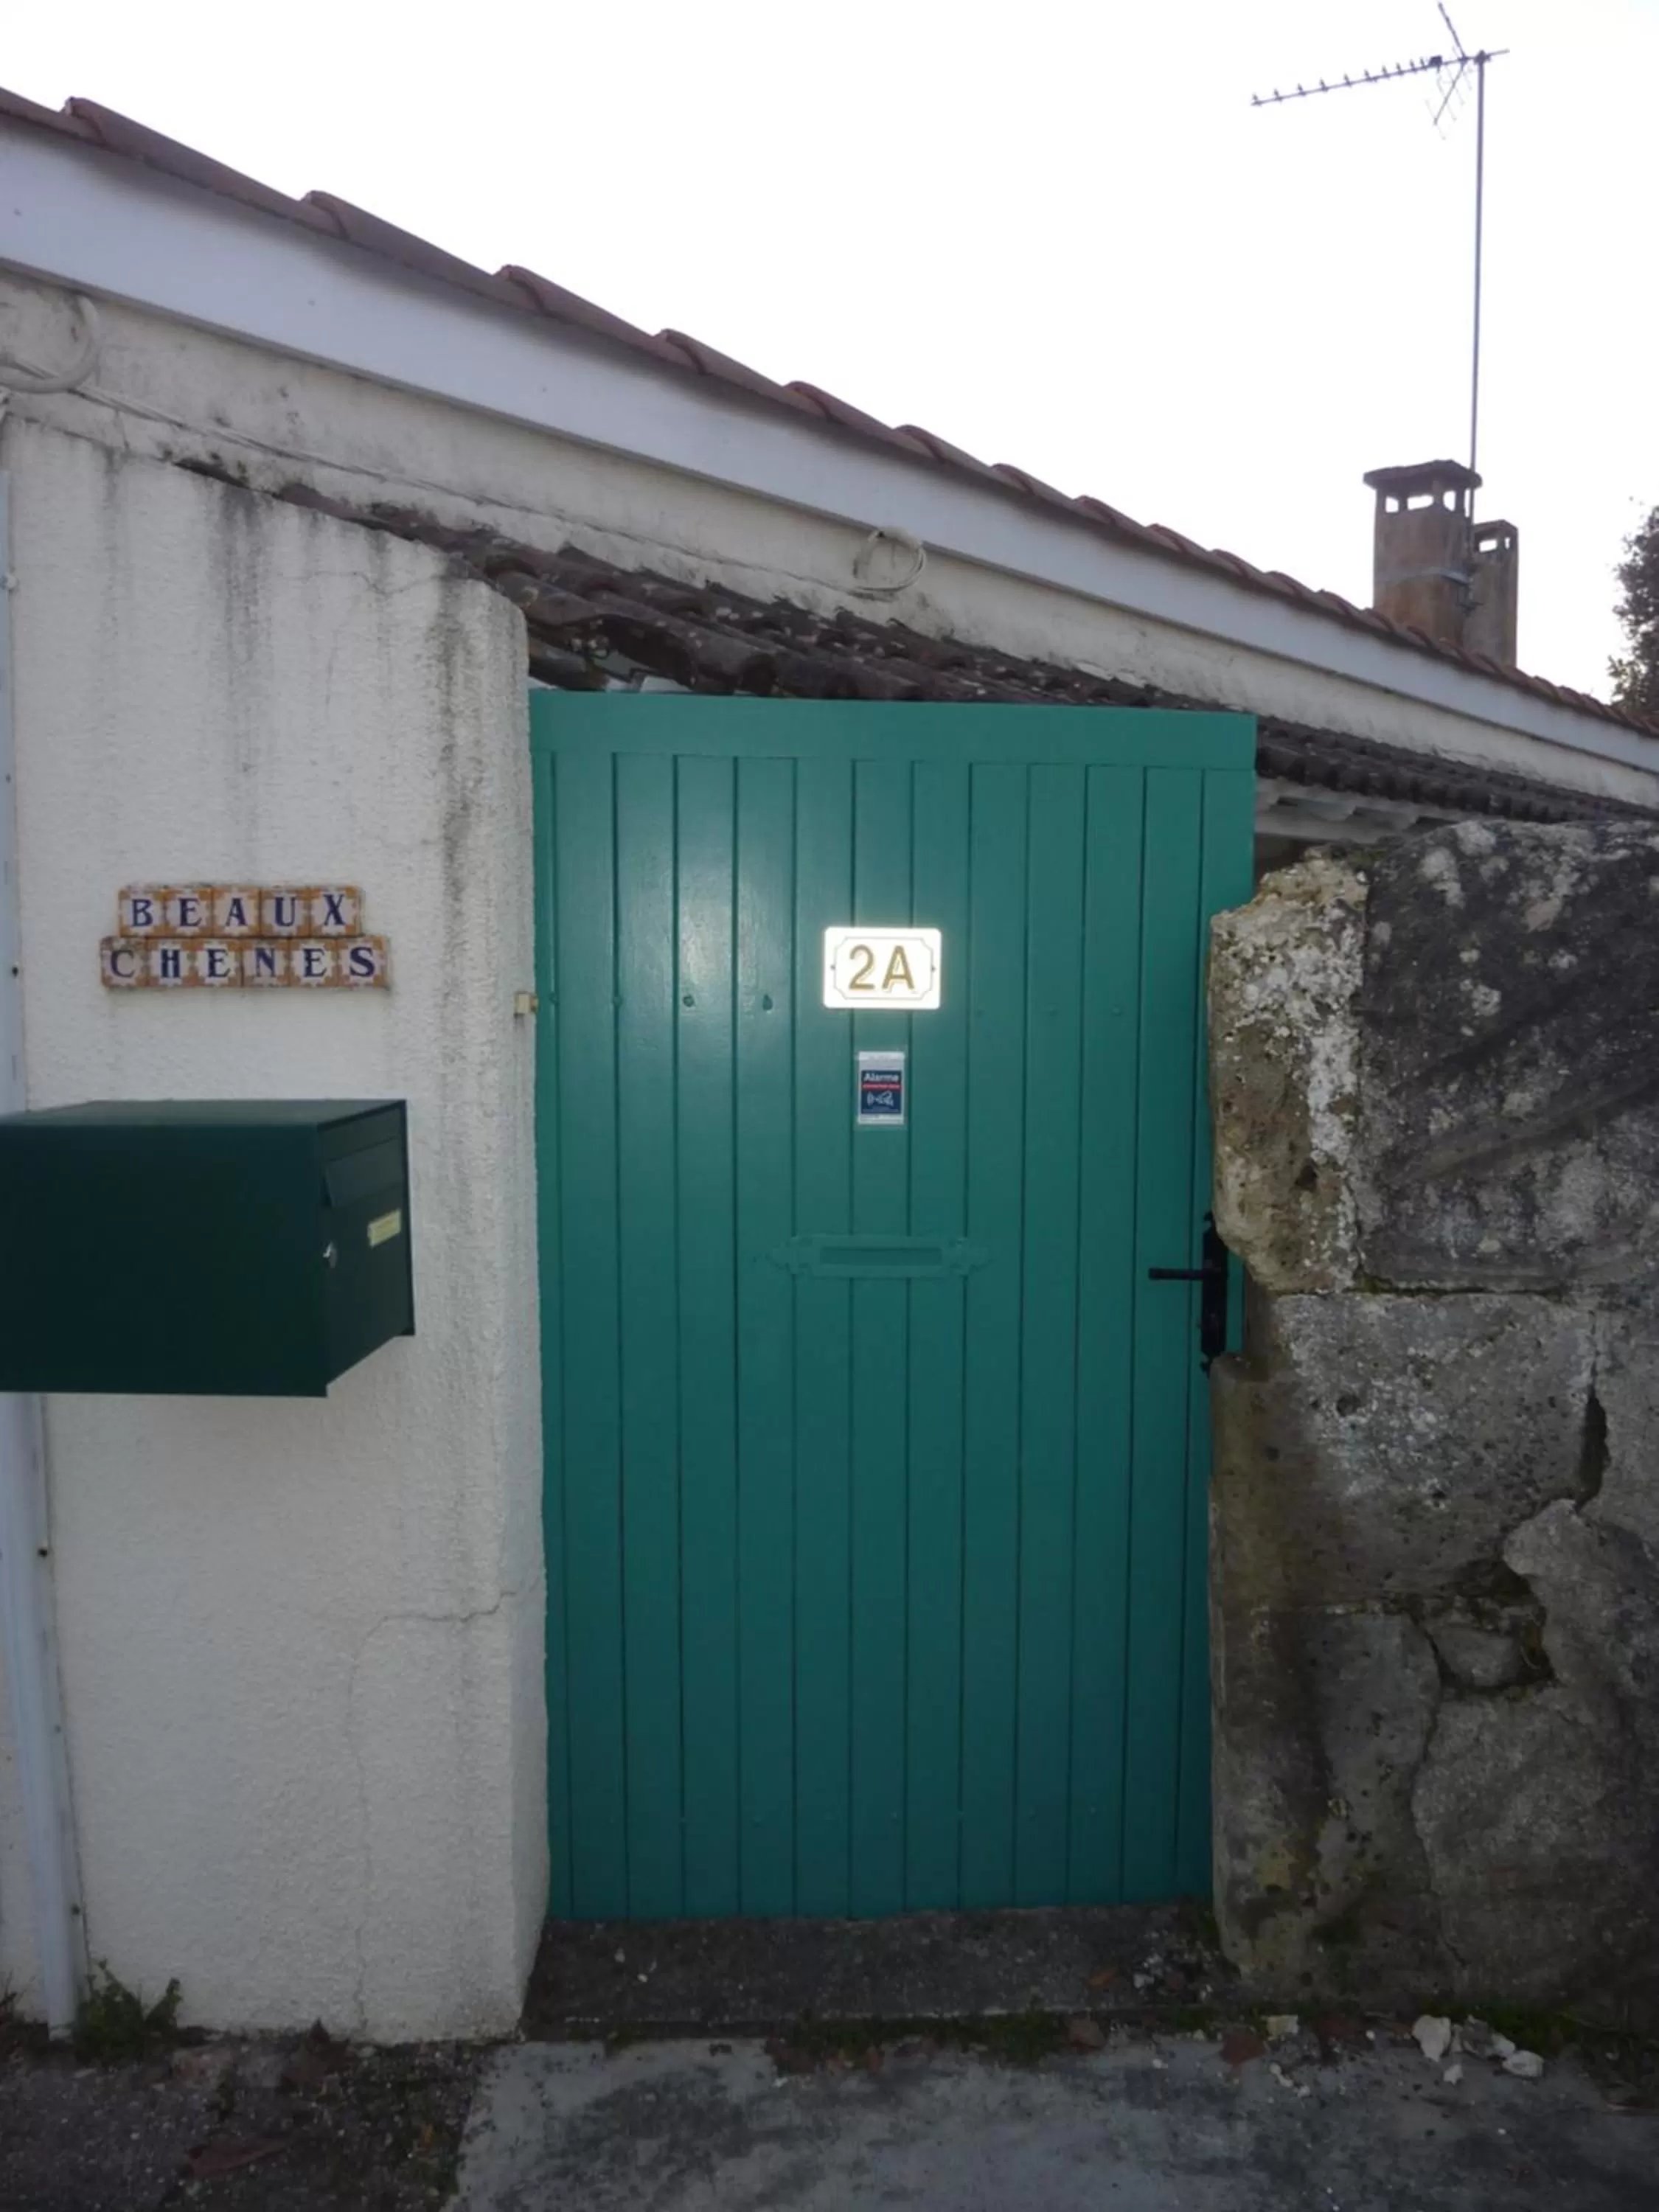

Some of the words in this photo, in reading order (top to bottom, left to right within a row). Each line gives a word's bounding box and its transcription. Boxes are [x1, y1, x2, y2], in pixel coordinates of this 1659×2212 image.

[131, 893, 347, 928] BEAUX
[108, 946, 377, 979] CHENES
[849, 944, 915, 990] 2A
